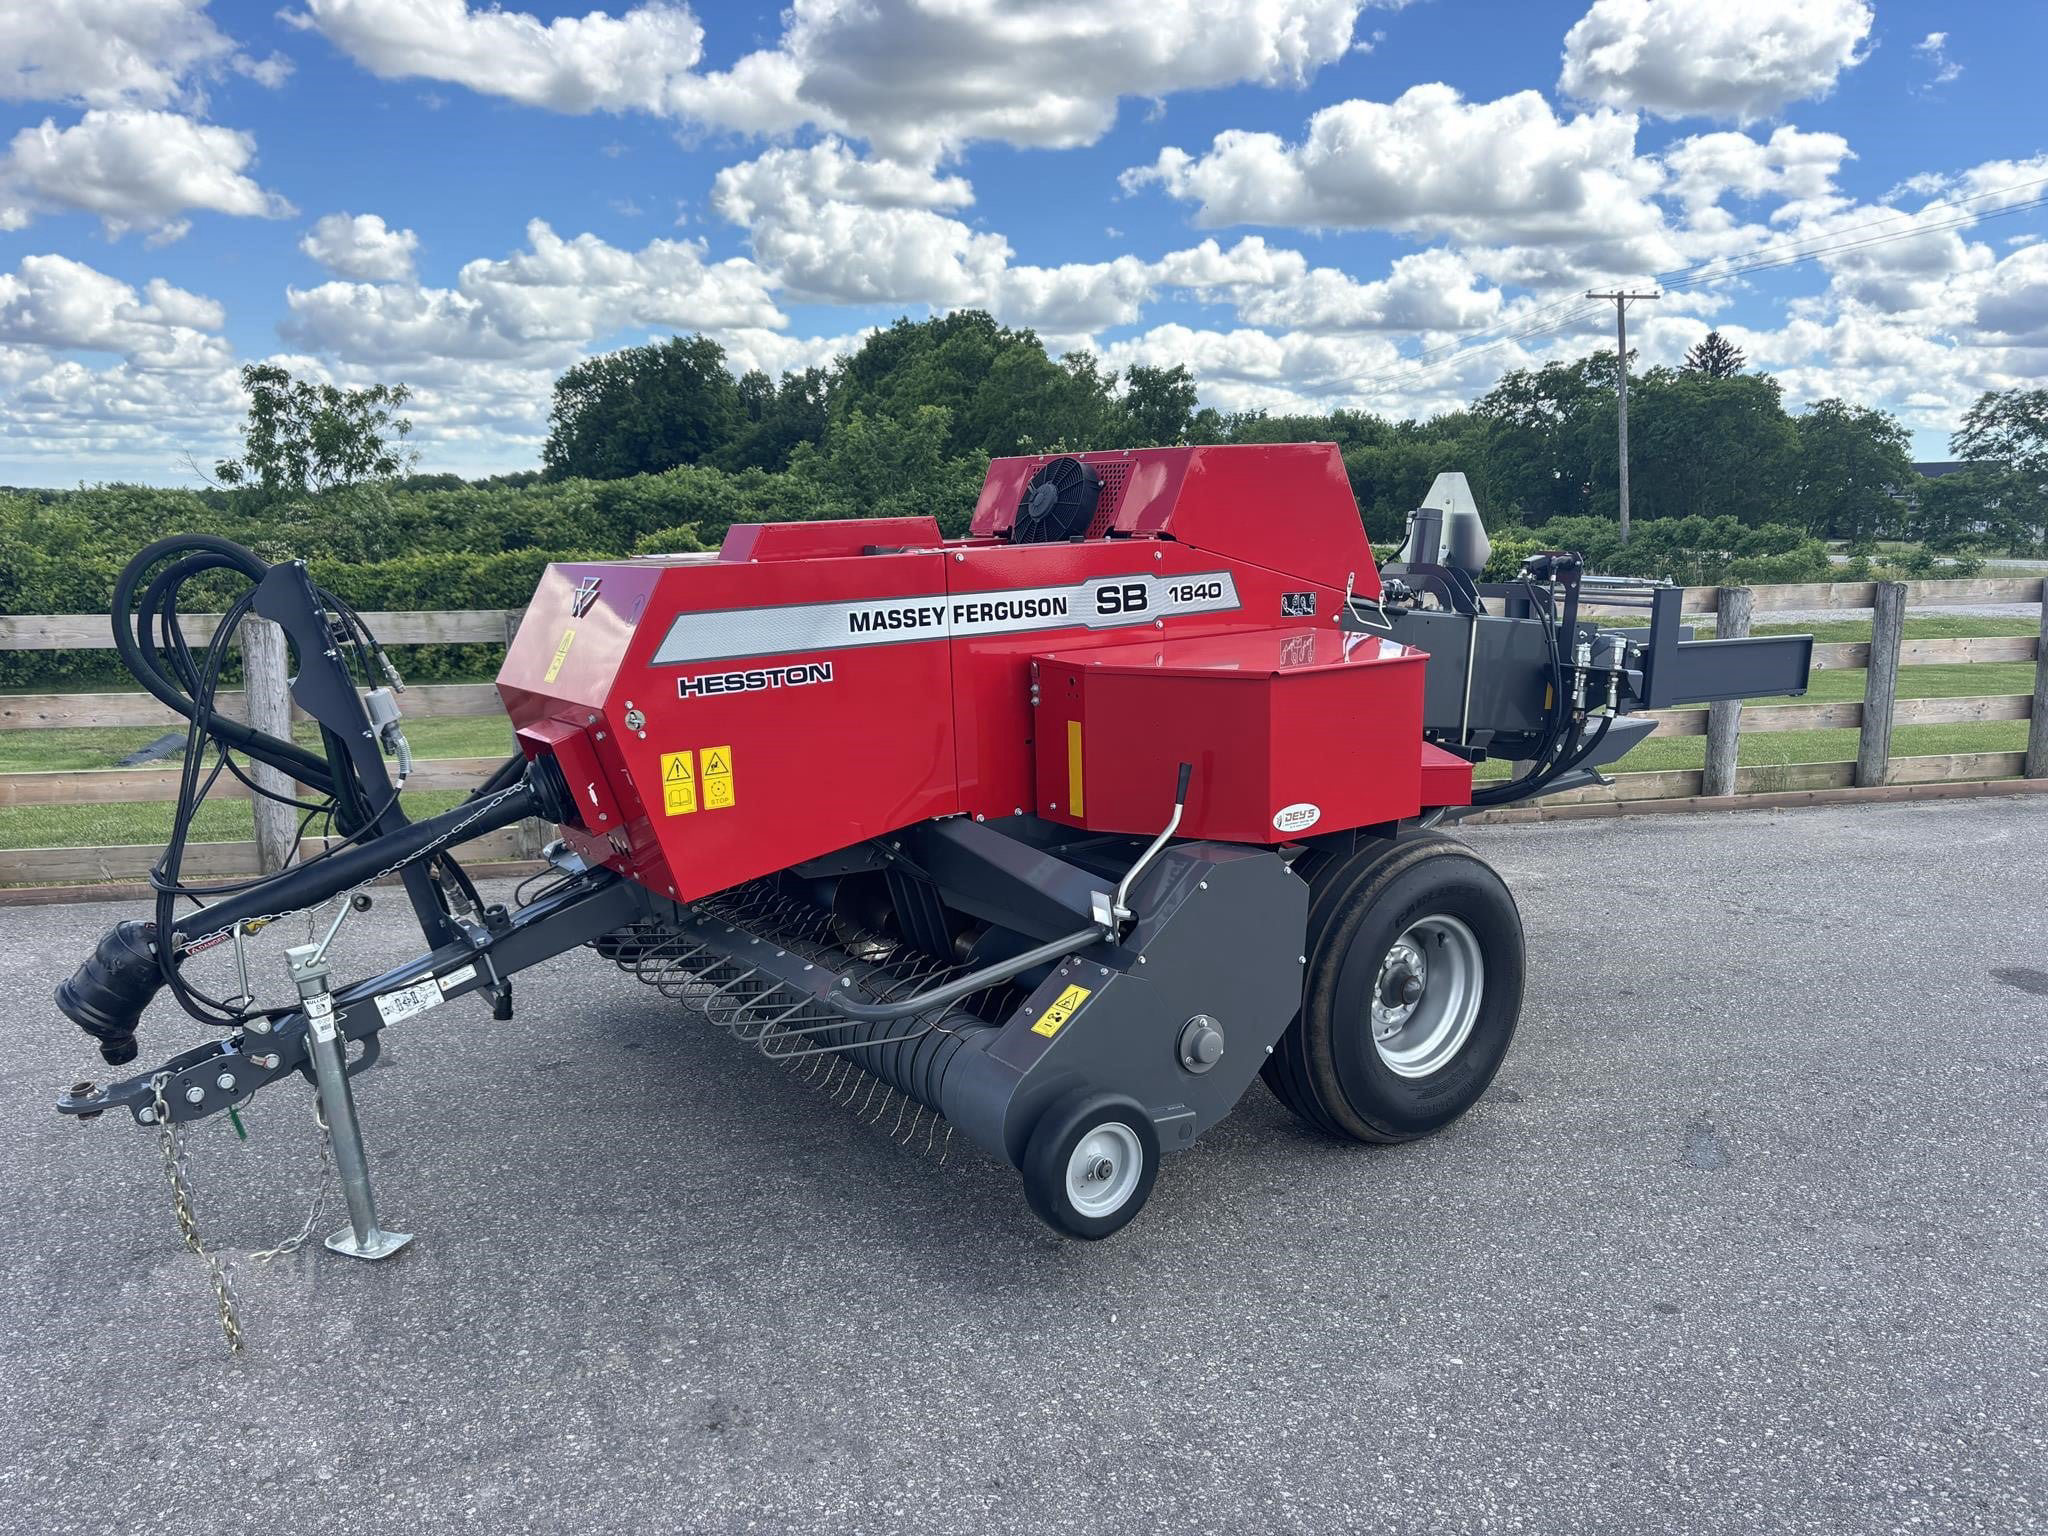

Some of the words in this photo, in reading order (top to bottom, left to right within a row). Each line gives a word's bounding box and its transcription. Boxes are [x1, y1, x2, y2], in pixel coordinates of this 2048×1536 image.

[849, 606, 946, 632] MASSEY
[953, 596, 1068, 624] FERGUSON
[1096, 583, 1149, 615] SB
[1168, 582, 1222, 602] 1840
[678, 662, 833, 698] HESSTON
[710, 797, 729, 805] STOP
[199, 935, 228, 951] DANGER
